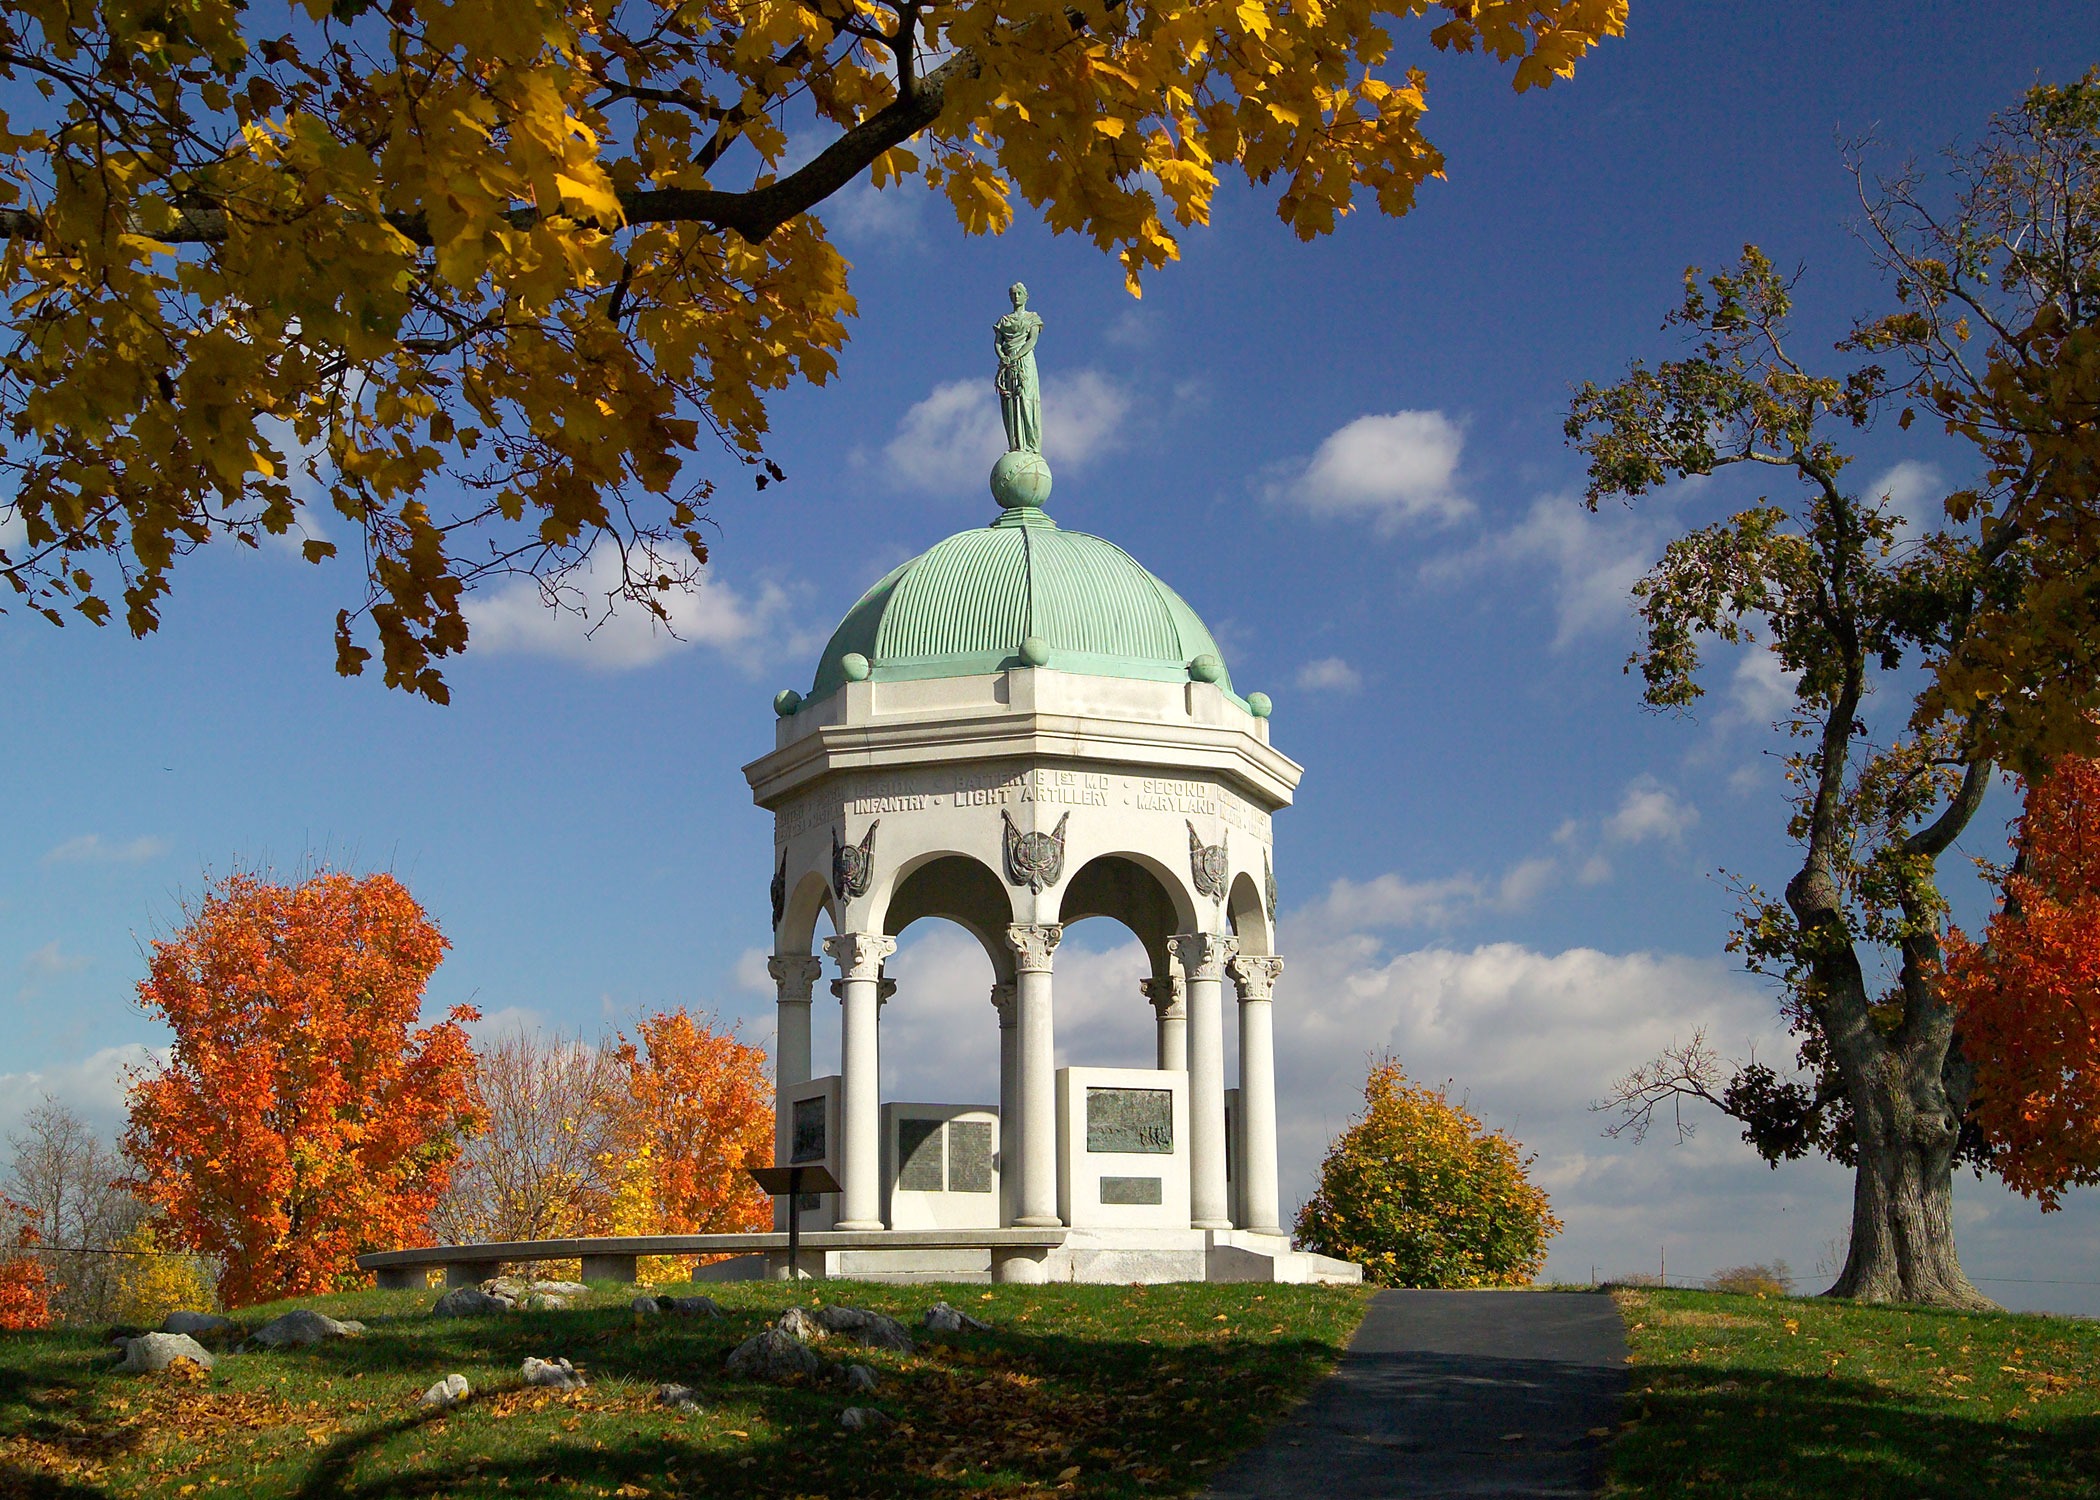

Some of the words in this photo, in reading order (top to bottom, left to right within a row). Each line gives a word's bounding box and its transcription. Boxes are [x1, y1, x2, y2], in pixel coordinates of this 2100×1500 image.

[856, 777, 915, 796] LEGION
[955, 772, 1027, 790] BATTERY
[1143, 779, 1206, 799] SECOND
[854, 794, 930, 815] INFANTRY
[954, 788, 1012, 808] LIGHT
[1020, 786, 1108, 807] ARTILLERY
[1137, 794, 1216, 815] MARYLAND
